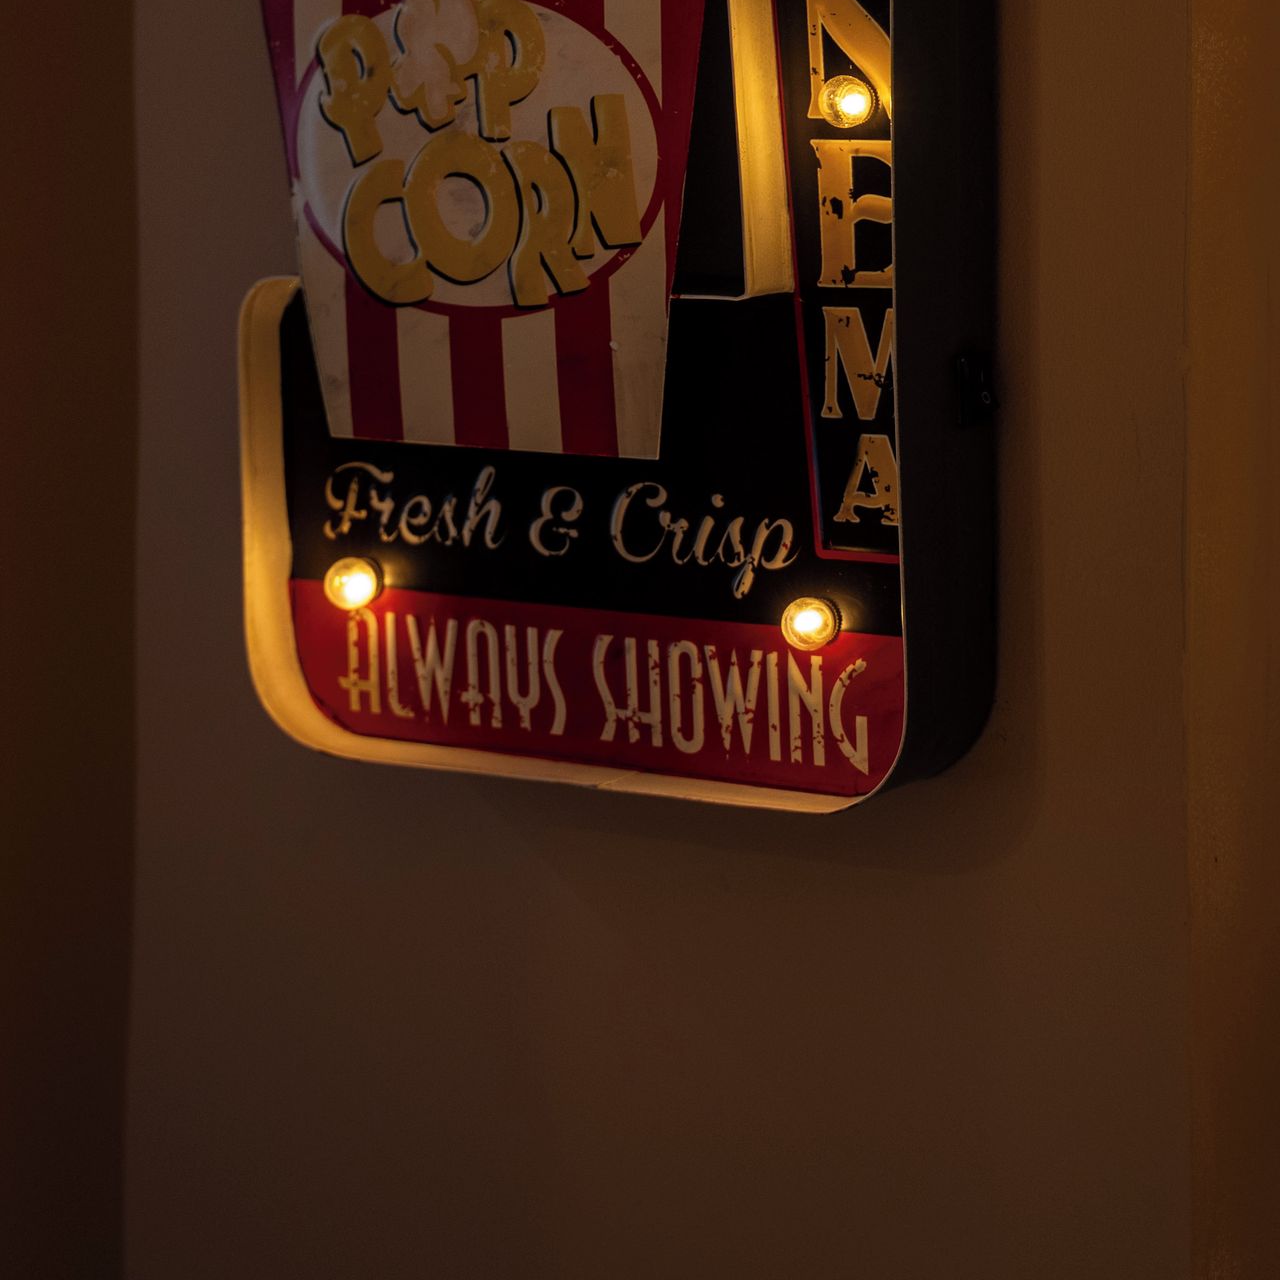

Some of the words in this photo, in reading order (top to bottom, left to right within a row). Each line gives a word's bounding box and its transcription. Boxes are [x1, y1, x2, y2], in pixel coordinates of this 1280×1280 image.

[342, 93, 642, 308] CORN
[323, 461, 508, 550] Fresh
[527, 485, 585, 558] &
[608, 480, 802, 600] Crisp
[337, 607, 566, 737] ALWAYS
[591, 631, 869, 776] SHOWING
